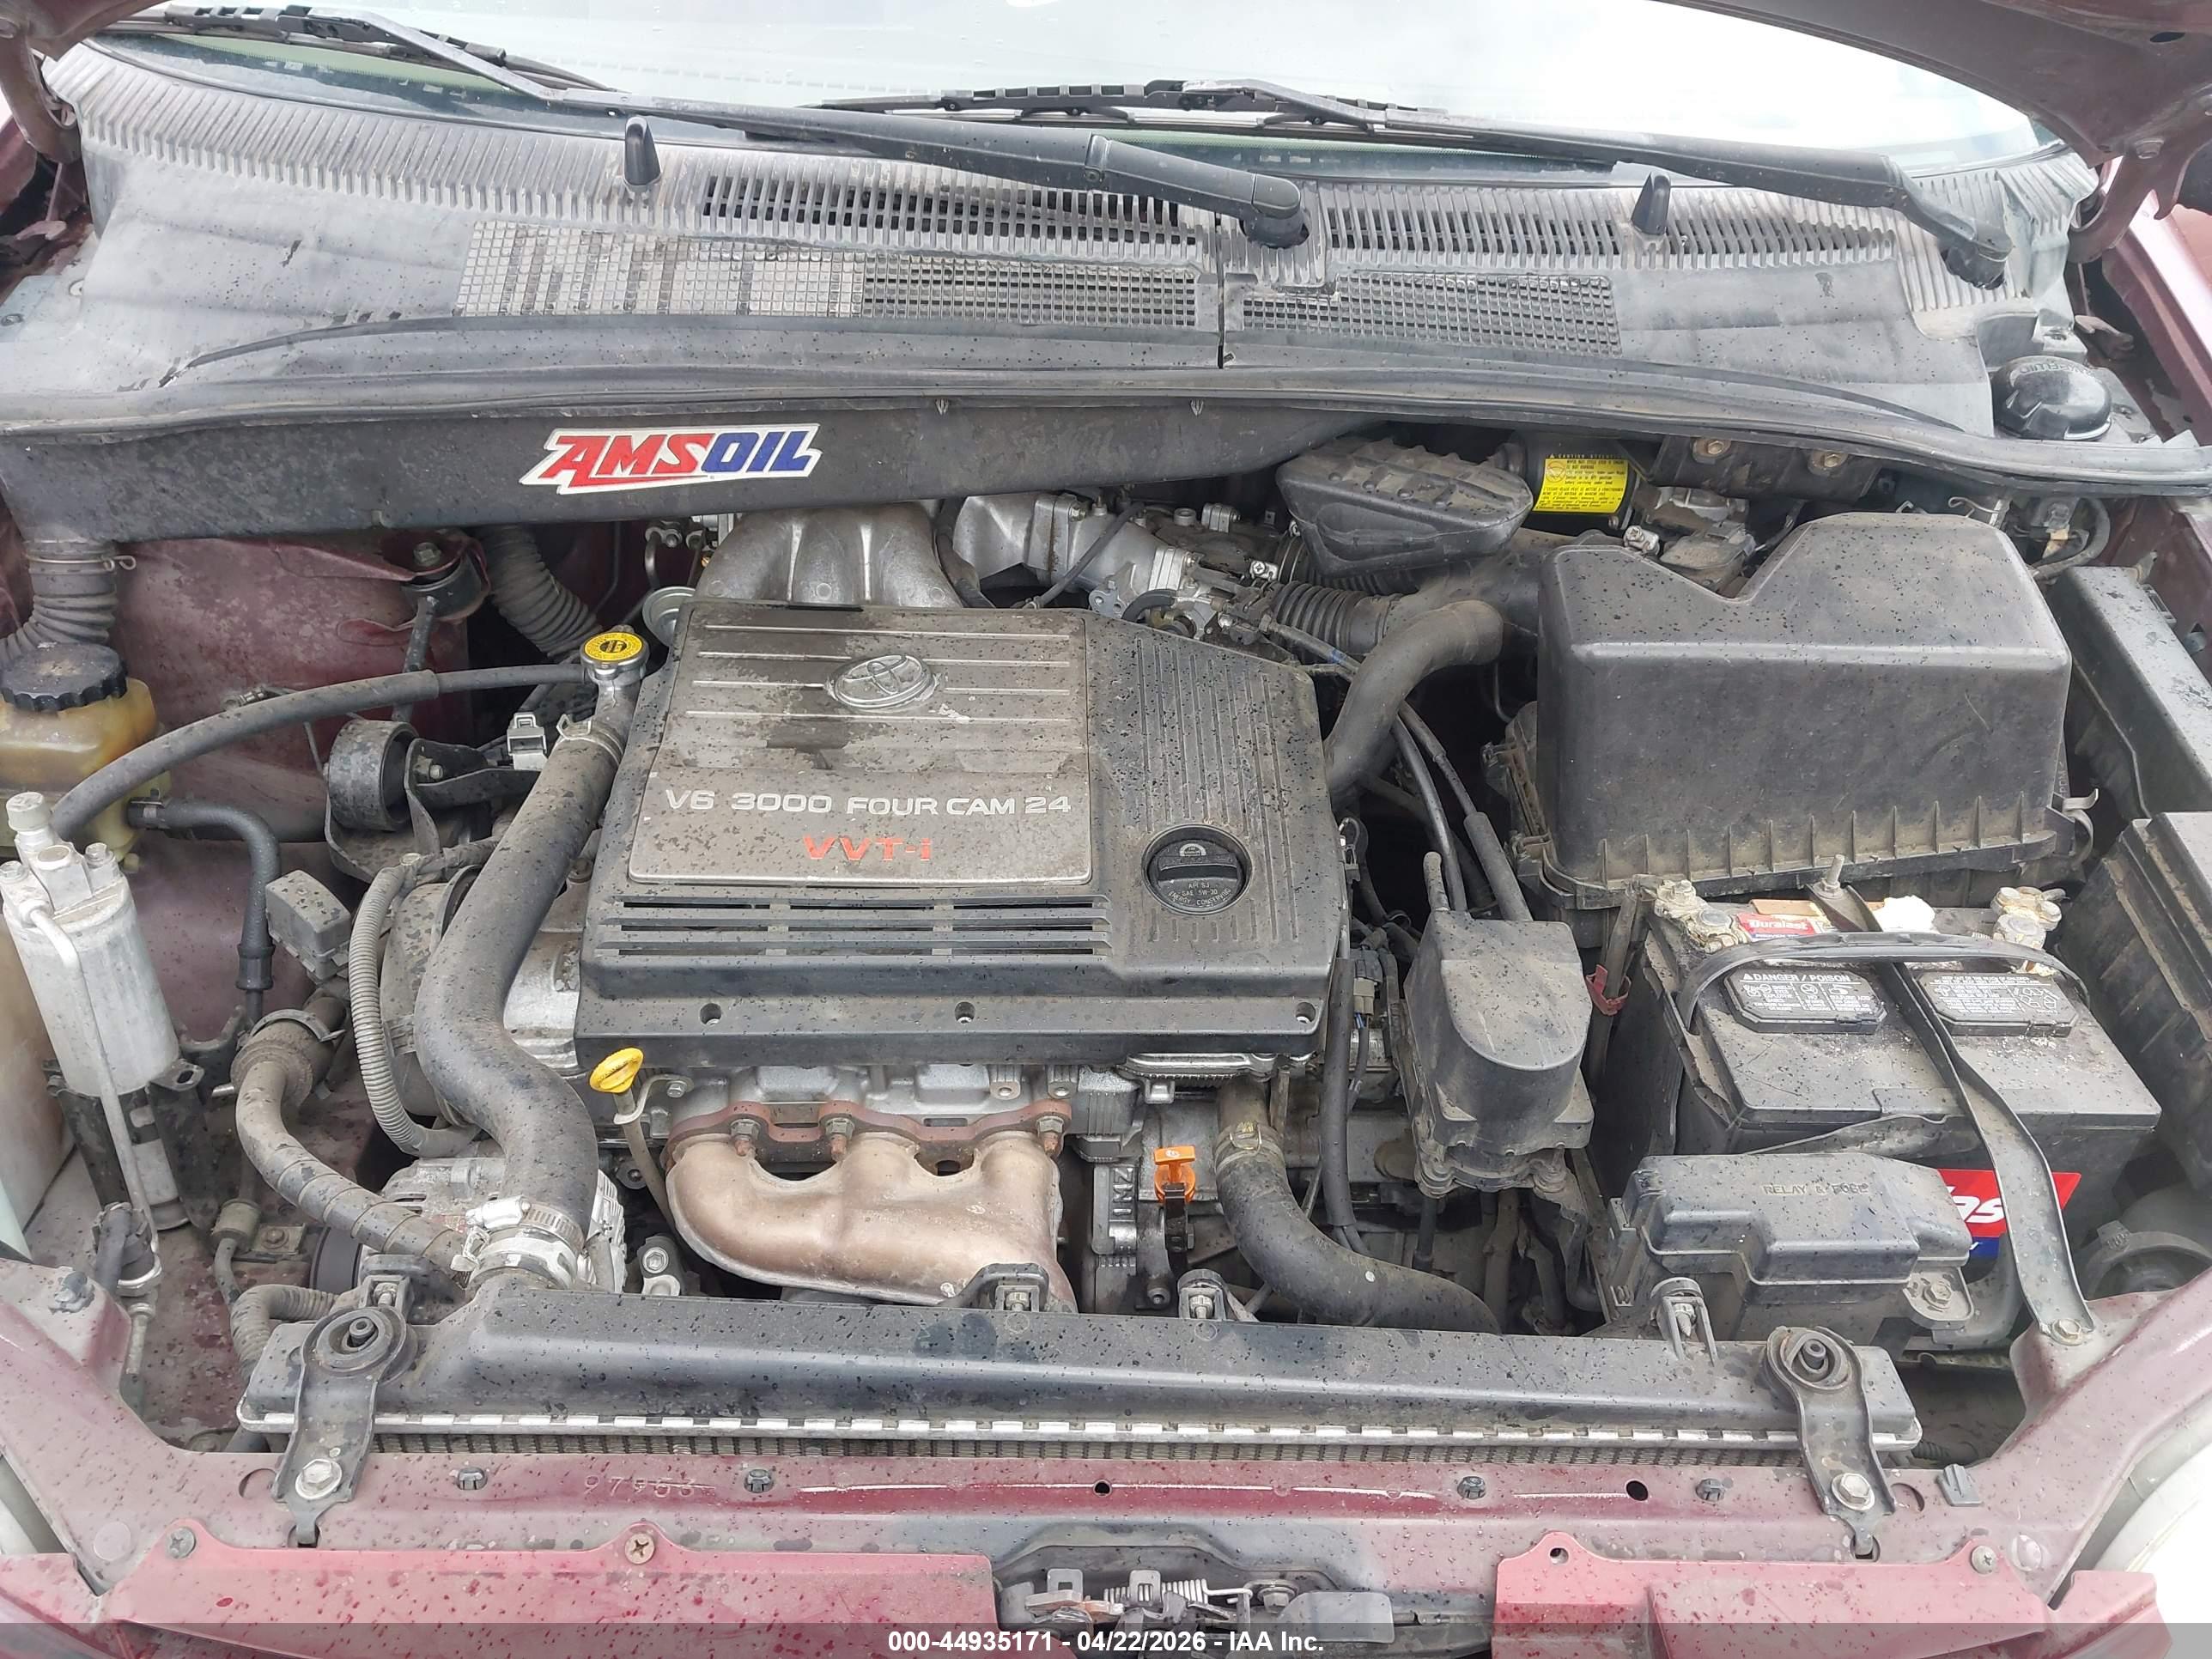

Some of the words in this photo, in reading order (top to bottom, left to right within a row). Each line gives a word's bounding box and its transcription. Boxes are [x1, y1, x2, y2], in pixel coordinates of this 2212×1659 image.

[538, 430, 814, 489] AMSOIL
[665, 788, 715, 811] V6
[731, 792, 833, 814] 3000
[846, 795, 939, 817] FOUR
[946, 796, 1016, 817] CAM
[1024, 795, 1073, 814] 24
[1747, 919, 1809, 931] Duralast
[1753, 973, 1800, 981] DANGER
[1763, 1185, 1806, 1195] RELAY
